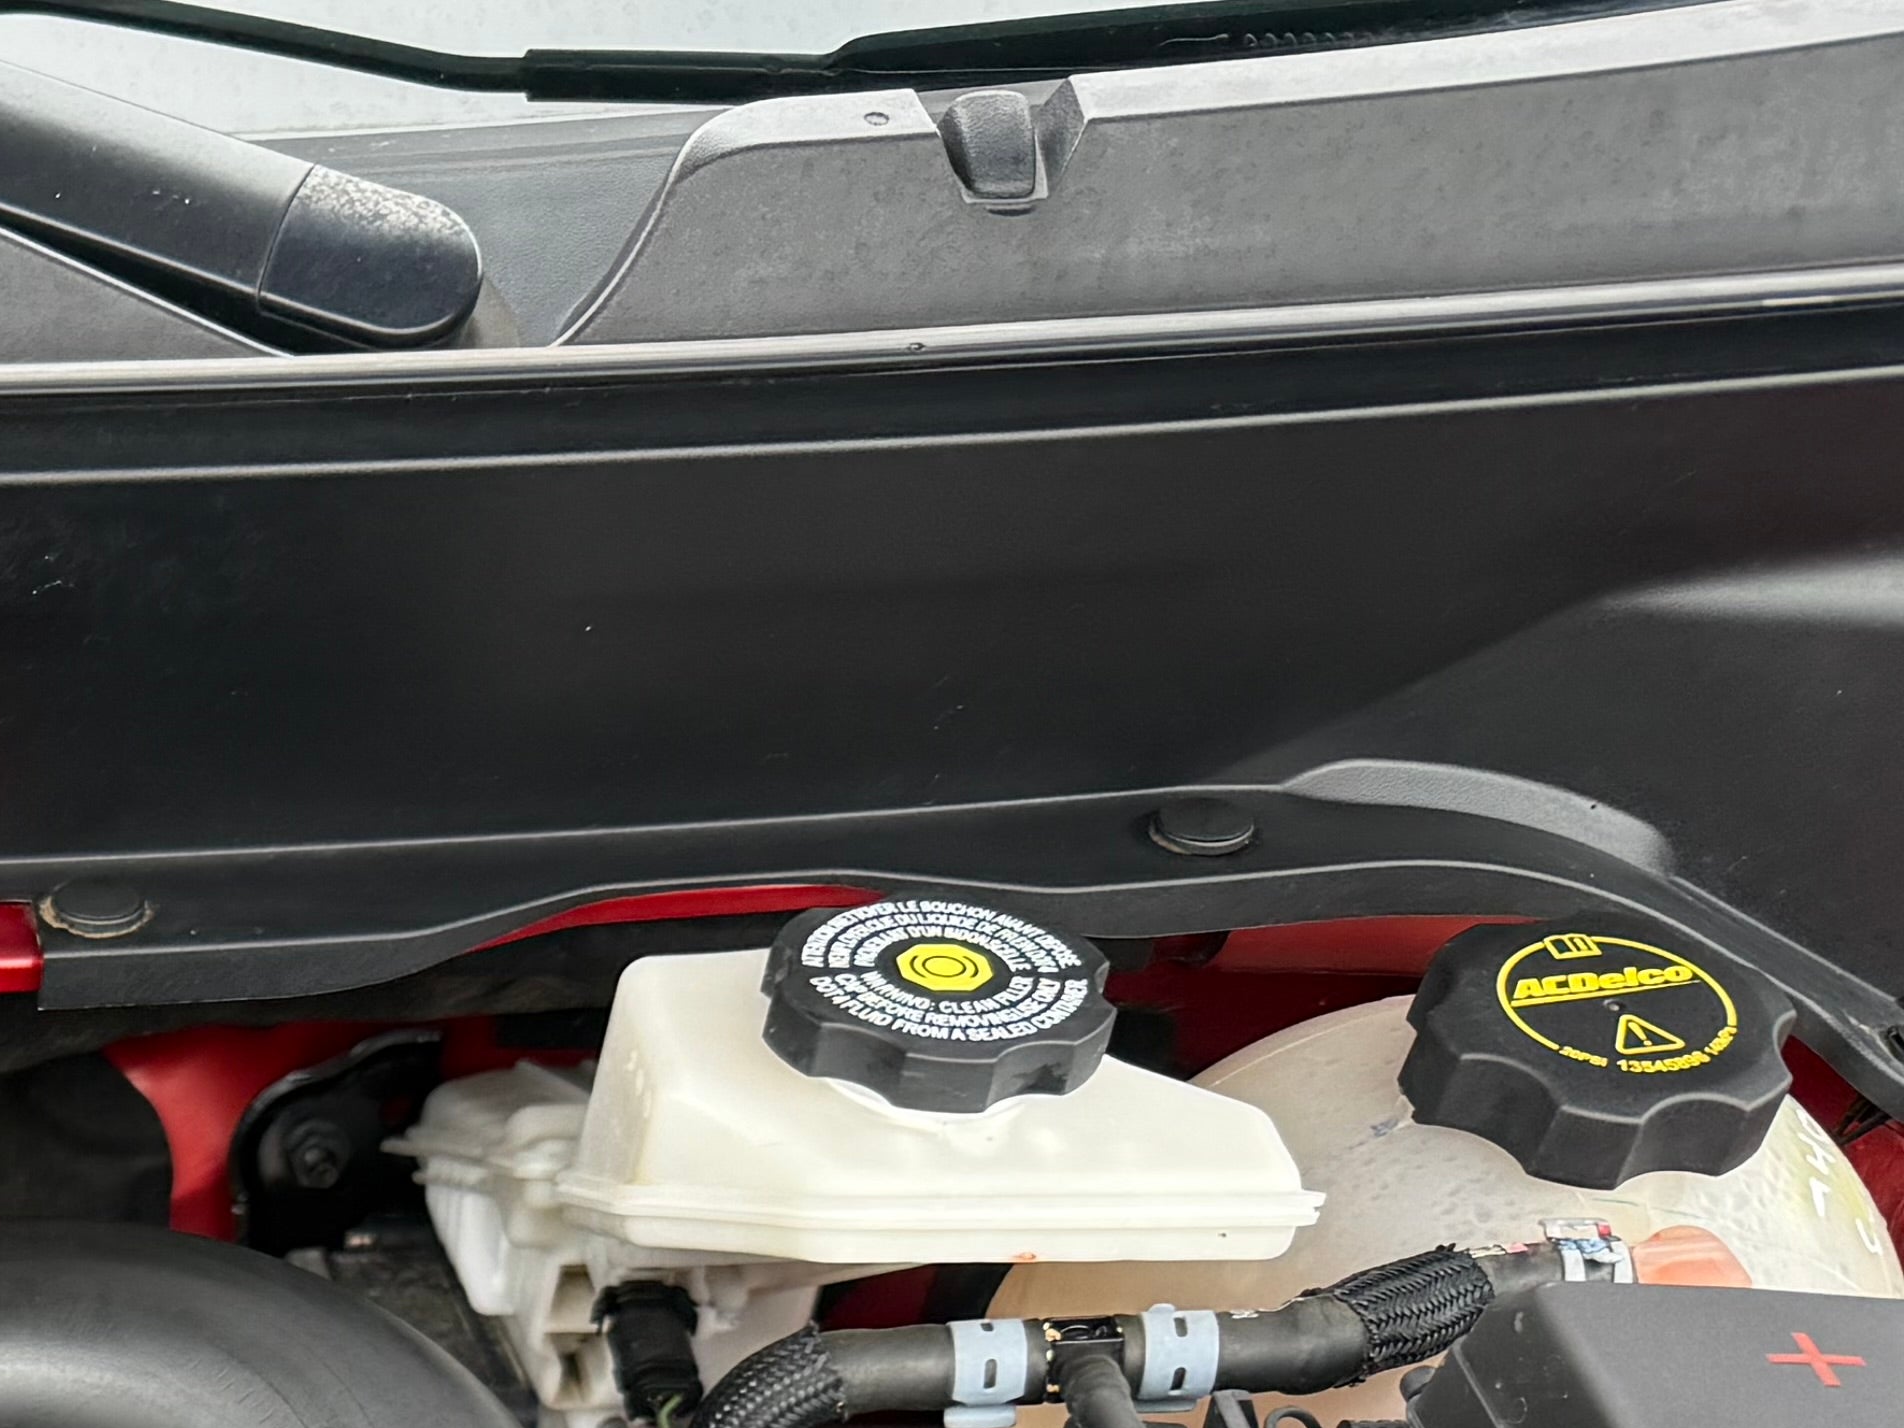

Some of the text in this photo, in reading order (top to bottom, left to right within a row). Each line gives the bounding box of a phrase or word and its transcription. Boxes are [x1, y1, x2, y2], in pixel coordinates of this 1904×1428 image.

[894, 913, 917, 927] DU
[896, 900, 920, 913] LE
[920, 900, 997, 921] BOUCHON
[1512, 965, 1693, 999] ACDelco
[834, 973, 869, 993] CAP
[857, 991, 925, 1023] BEFORE
[938, 997, 1000, 1013] CLEAN
[839, 999, 894, 1026] FLUID
[891, 1018, 948, 1039] FROM
[948, 1024, 966, 1041] A
[964, 1021, 1039, 1042] SEALED
